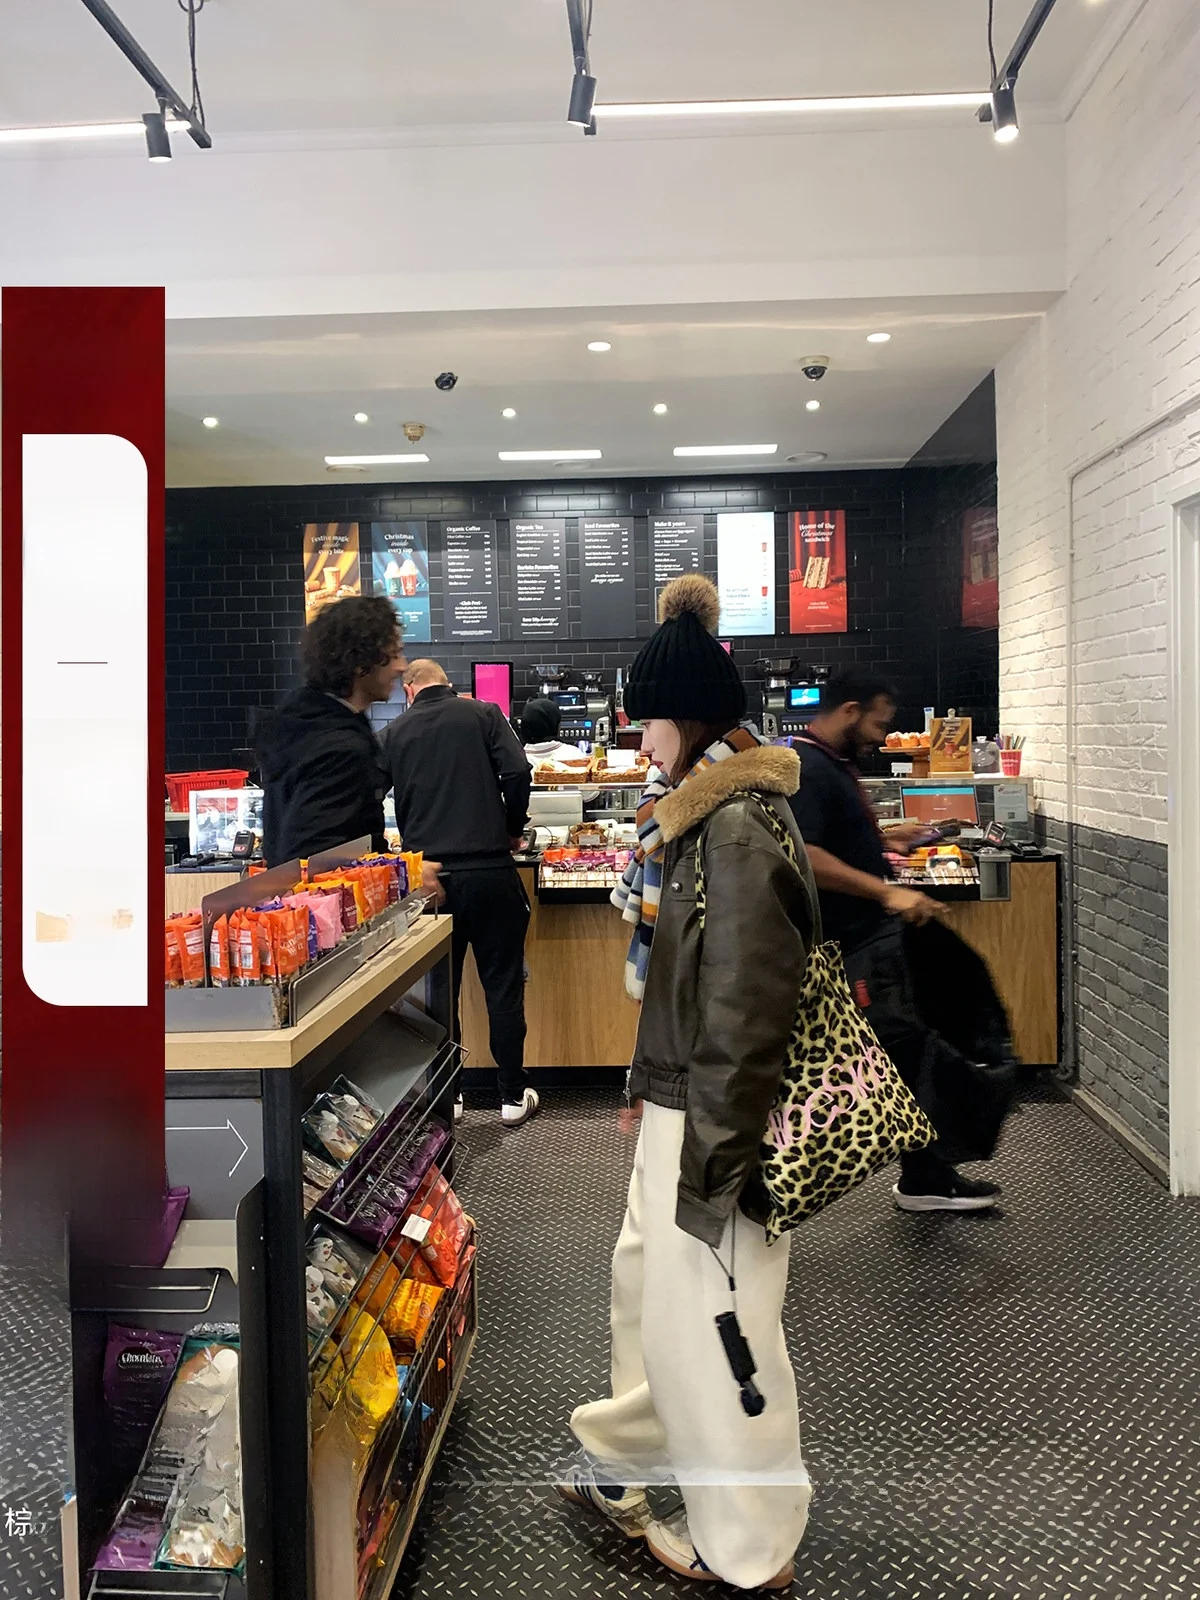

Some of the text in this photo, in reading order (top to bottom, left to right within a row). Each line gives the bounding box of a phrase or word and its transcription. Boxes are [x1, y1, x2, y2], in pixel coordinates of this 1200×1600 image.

[515, 524, 534, 532] Organic
[799, 524, 817, 532] Home
[384, 533, 415, 541] Christmas
[801, 530, 834, 538] Christmas
[311, 535, 350, 543] Festive magic
